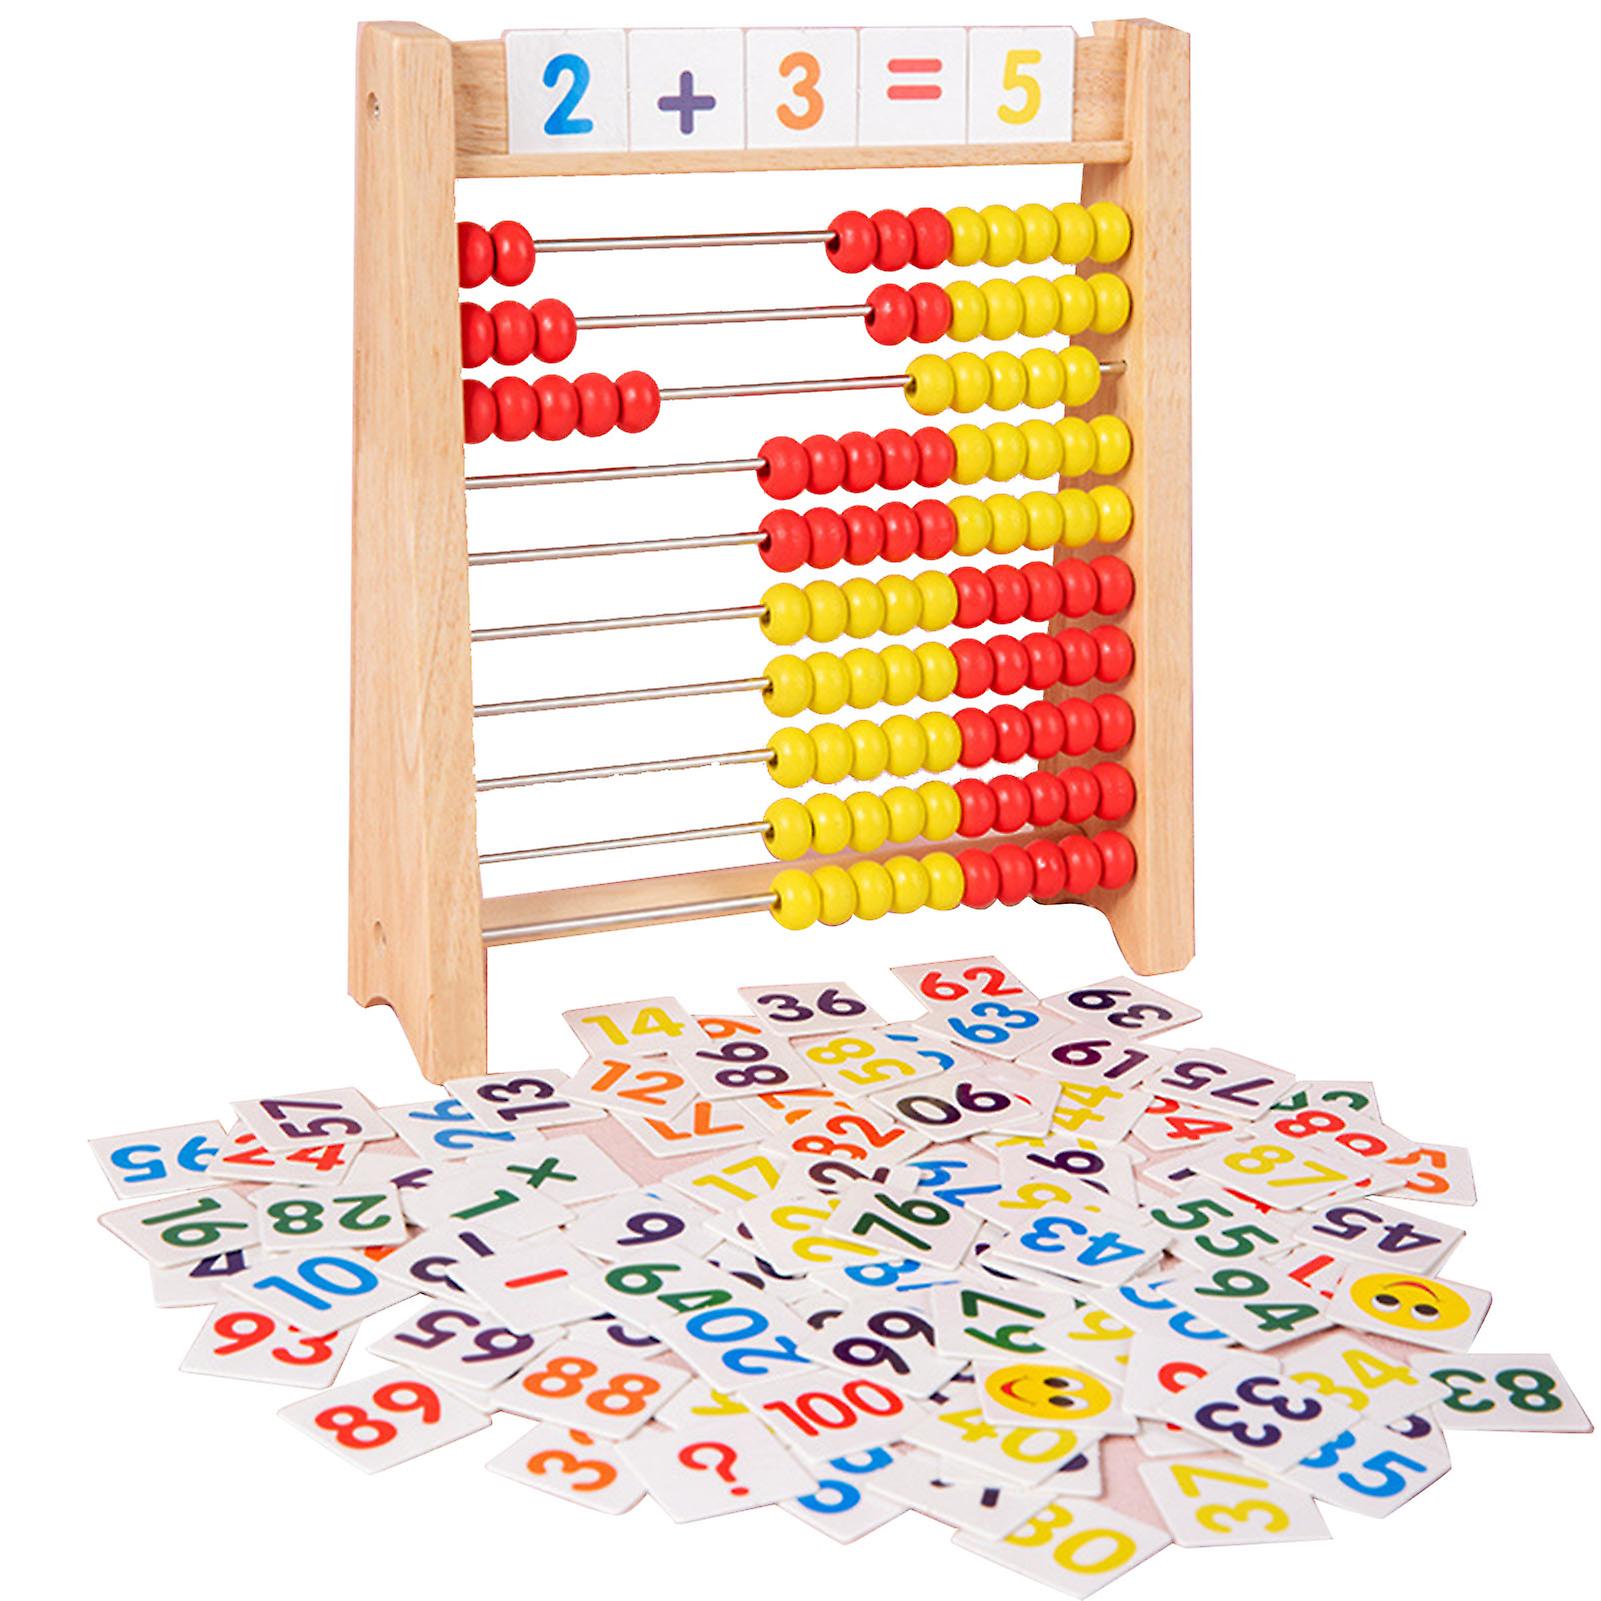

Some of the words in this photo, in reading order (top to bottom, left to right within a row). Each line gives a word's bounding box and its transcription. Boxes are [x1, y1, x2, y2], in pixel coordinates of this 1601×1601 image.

[542, 53, 594, 135] 2
[775, 50, 825, 131] 3
[996, 49, 1042, 125] 5
[757, 988, 867, 1023] 36
[920, 966, 1024, 1001] 62
[581, 1006, 686, 1045] 14
[947, 1002, 1040, 1044] 63
[477, 1078, 570, 1122] 13
[591, 1059, 685, 1105] 12
[1151, 1199, 1279, 1257] 55
[253, 1256, 379, 1311] 10
[522, 1356, 661, 1416] 88
[762, 1378, 904, 1436] 100
